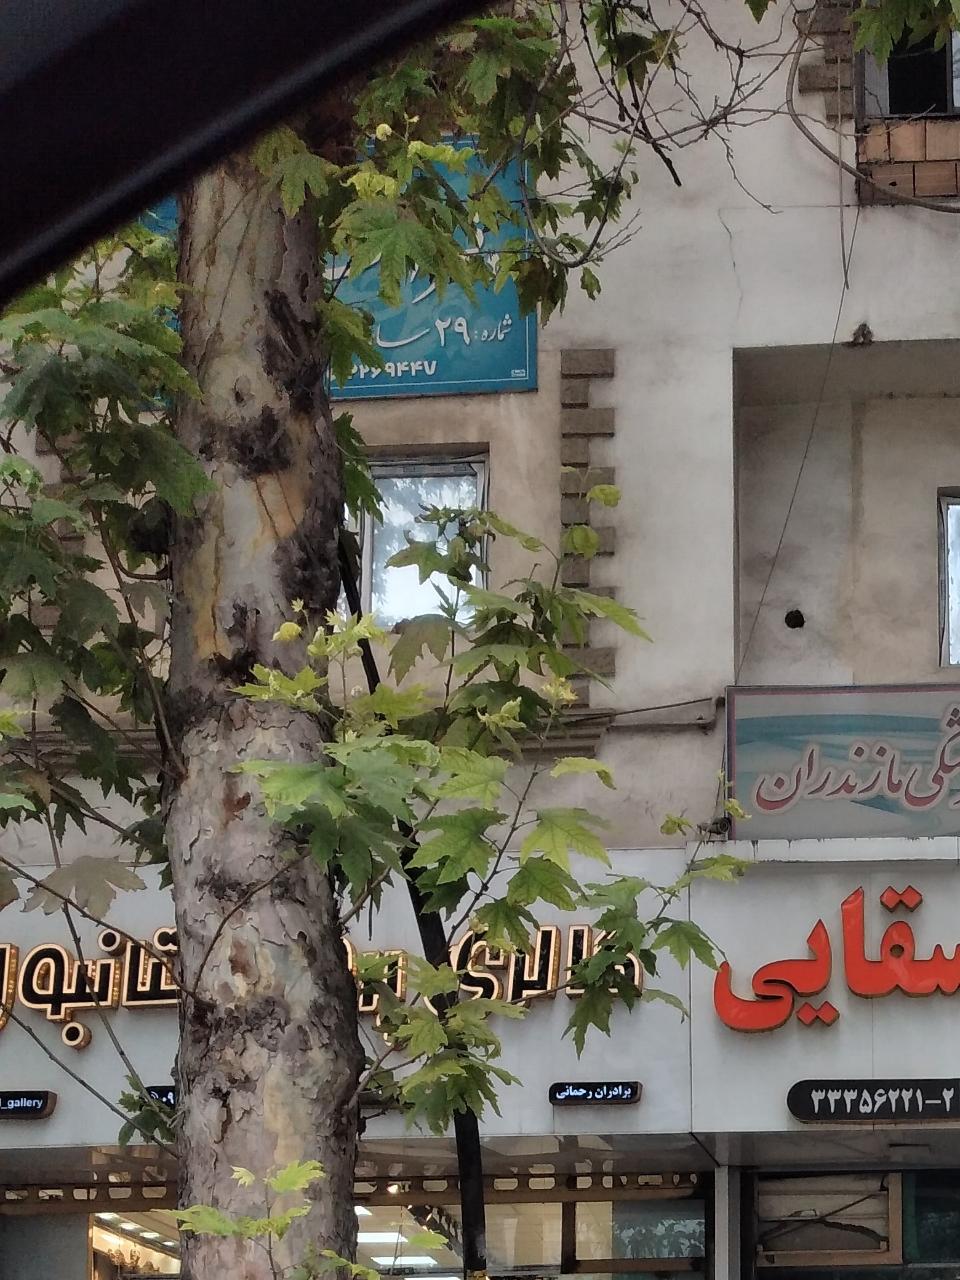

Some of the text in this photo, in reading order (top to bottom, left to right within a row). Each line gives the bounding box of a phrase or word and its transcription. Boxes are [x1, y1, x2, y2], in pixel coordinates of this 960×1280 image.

[755, 745, 903, 811] مازندران
[555, 1085, 632, 1100] برادران رحمانی
[810, 1087, 955, 1114] ۳۳۳۵۶۲۲۱-۲
